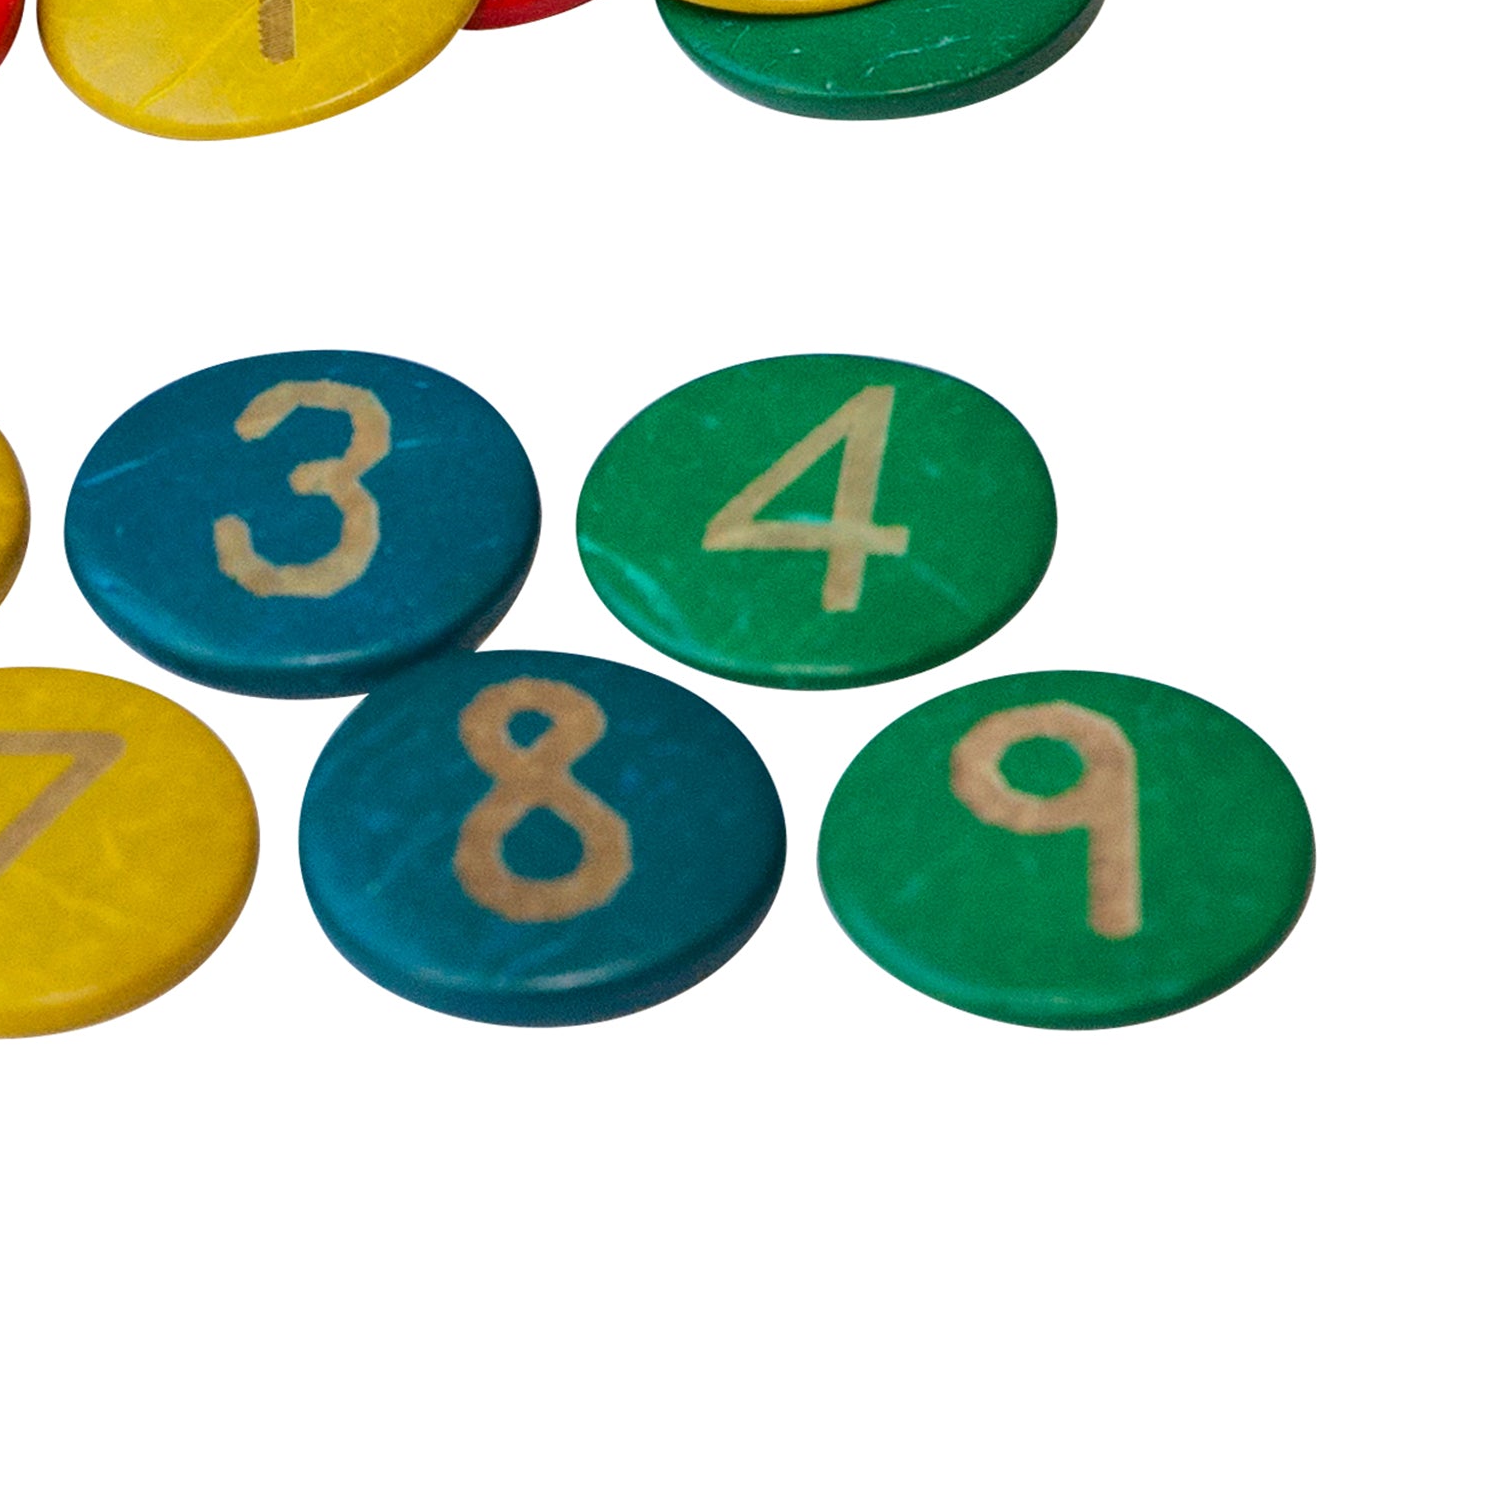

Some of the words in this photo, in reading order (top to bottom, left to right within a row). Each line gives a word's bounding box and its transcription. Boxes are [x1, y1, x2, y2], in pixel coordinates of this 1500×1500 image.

[214, 379, 391, 599] 3
[702, 384, 911, 613] 4
[453, 676, 633, 923] 8
[950, 700, 1141, 940] 9
